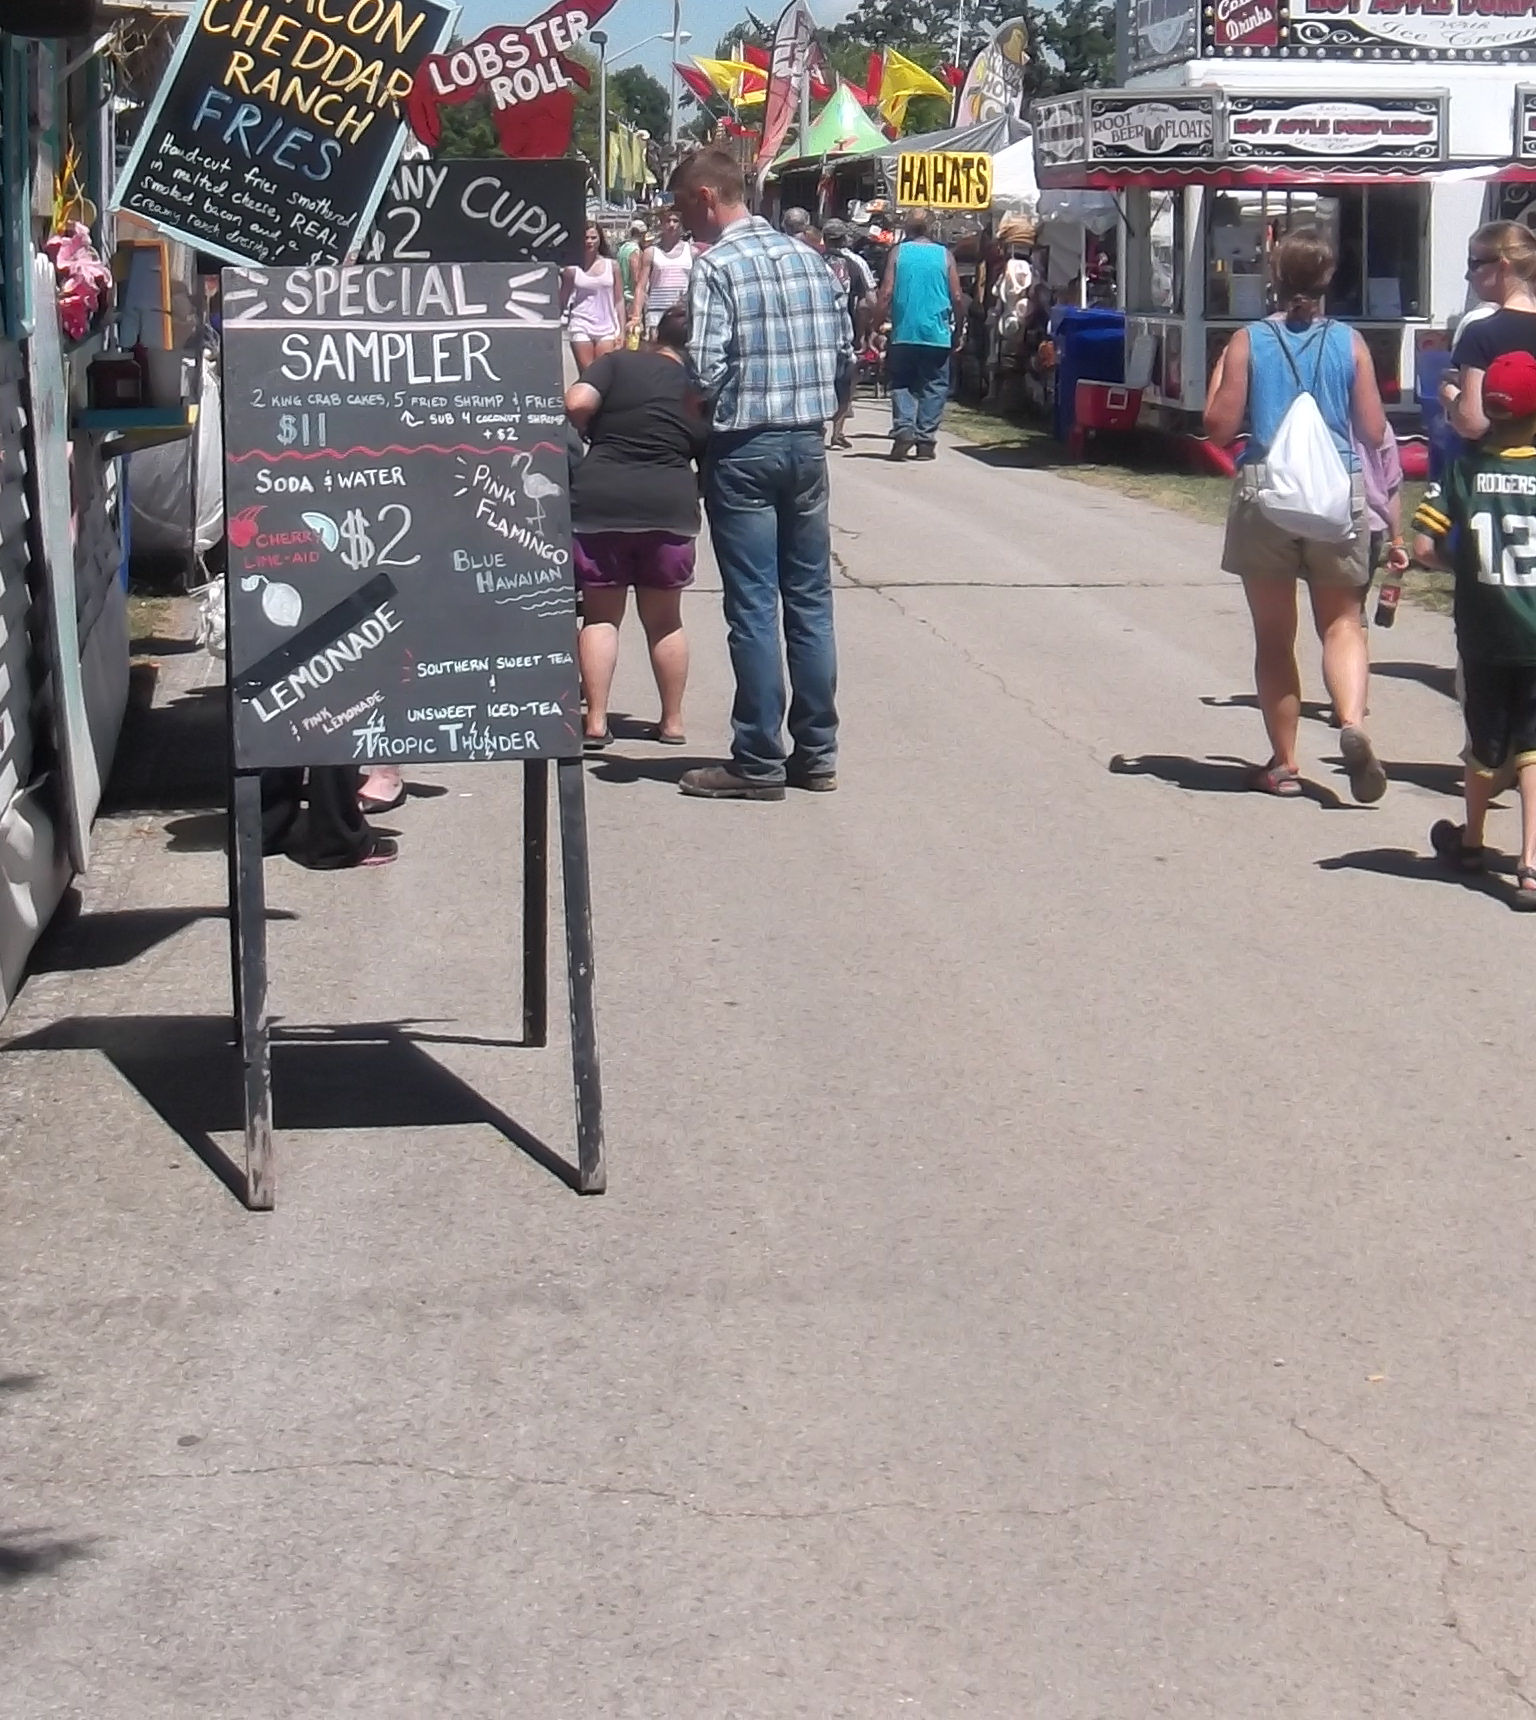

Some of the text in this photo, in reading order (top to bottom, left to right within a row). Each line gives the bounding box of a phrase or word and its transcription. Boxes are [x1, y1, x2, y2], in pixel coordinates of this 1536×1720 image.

[1225, 4, 1273, 41] Drinks
[1371, 20, 1429, 43] Ice
[429, 10, 590, 96] LOBSTER
[223, 49, 376, 145] RANCH
[490, 57, 573, 111] ROLL
[192, 86, 343, 181] FRIES
[1093, 112, 1212, 138] ROOT FLOATS
[1110, 124, 1145, 143] BEER
[244, 166, 279, 195] fries
[150, 159, 164, 172] in
[172, 167, 226, 199] melted
[289, 213, 339, 250] REAL
[203, 198, 243, 227] bacon
[249, 221, 279, 243] and
[282, 264, 488, 317] SPECIAL
[280, 331, 501, 384] SAMPLER
[250, 389, 266, 407] 2
[271, 395, 303, 408] KING
[307, 392, 342, 406] CRAB
[346, 393, 390, 409] CAKES,
[393, 391, 404, 407] 5
[411, 395, 448, 409] FRIED
[454, 394, 505, 407] SHRIMP
[525, 395, 565, 409] FRIES
[276, 411, 566, 447] $11 SUB 4 COCONUT SHRIMP
[496, 426, 519, 442] $2
[255, 469, 315, 495] SODA
[337, 466, 407, 488] WATER
[472, 464, 517, 507] PINK
[340, 503, 421, 570] $2
[474, 498, 570, 566] FLAMINGO
[453, 549, 507, 572] BLUE
[475, 565, 563, 594] HAWAIIAN
[249, 600, 405, 723] LEMONADE
[417, 652, 574, 678] SOUTHERN SWEET TEA
[301, 705, 333, 732] PINK
[321, 689, 386, 735] LEMONADE
[407, 701, 563, 722] UNSWEET ICED-TEA
[352, 722, 541, 760] TROPIC THUNDER
